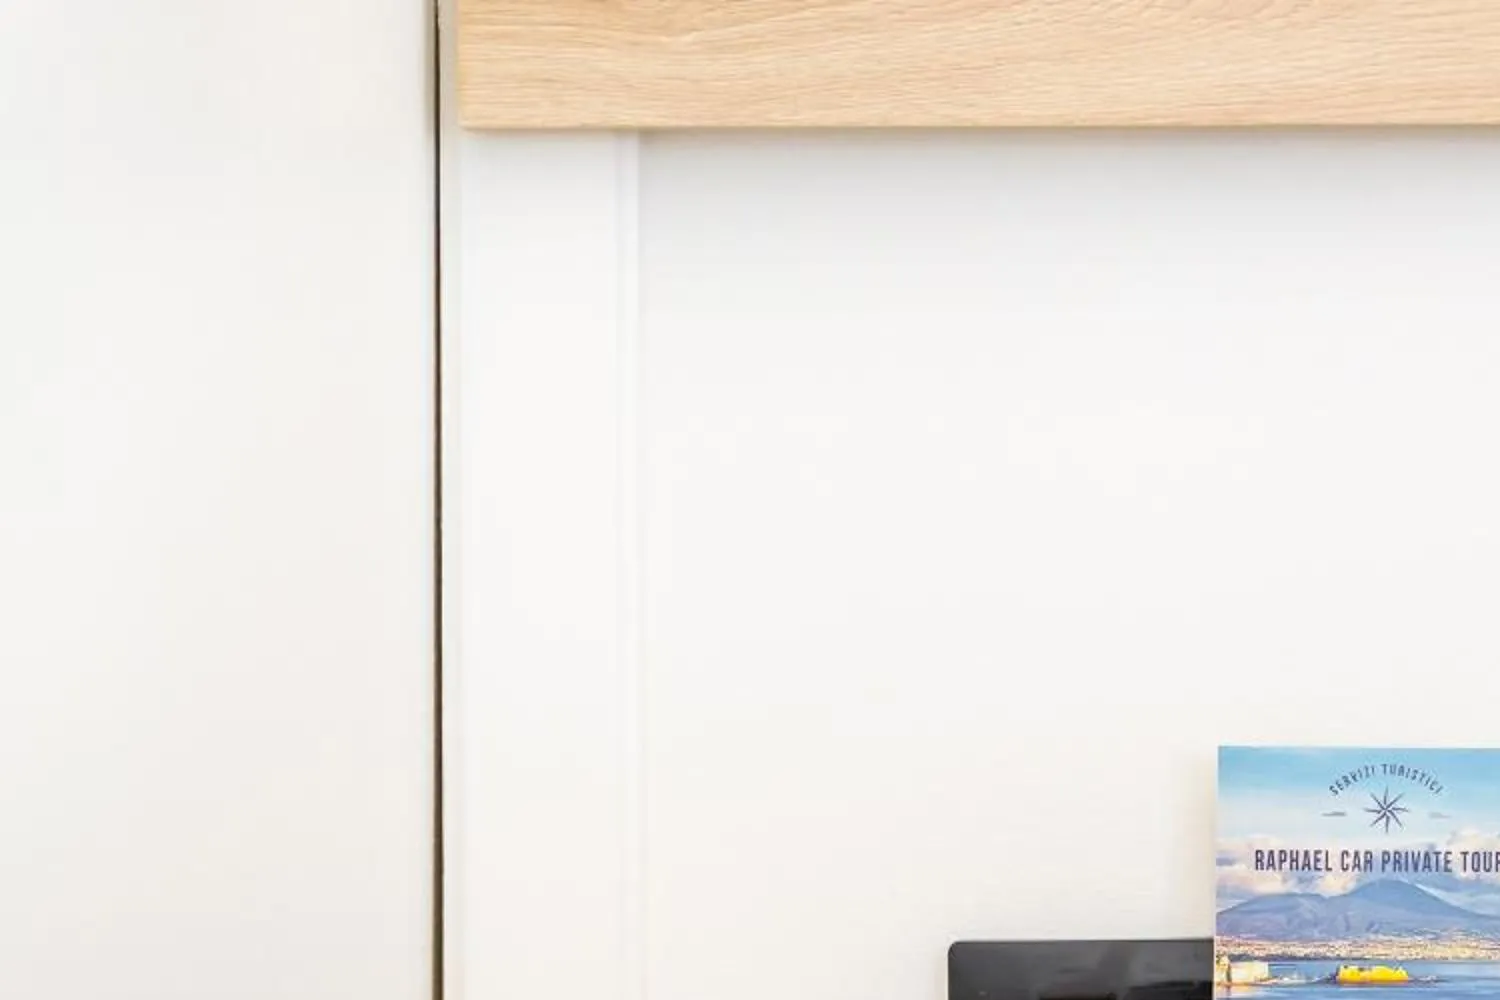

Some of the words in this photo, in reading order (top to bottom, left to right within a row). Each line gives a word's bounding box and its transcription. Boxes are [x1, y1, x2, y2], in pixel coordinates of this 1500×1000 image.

[1329, 764, 1376, 796] SERVIZI
[1381, 763, 1444, 794] TURISTICI
[1254, 849, 1333, 872] RAPHAEL
[1340, 850, 1374, 873] CAR
[1381, 850, 1453, 873] PRIVATE
